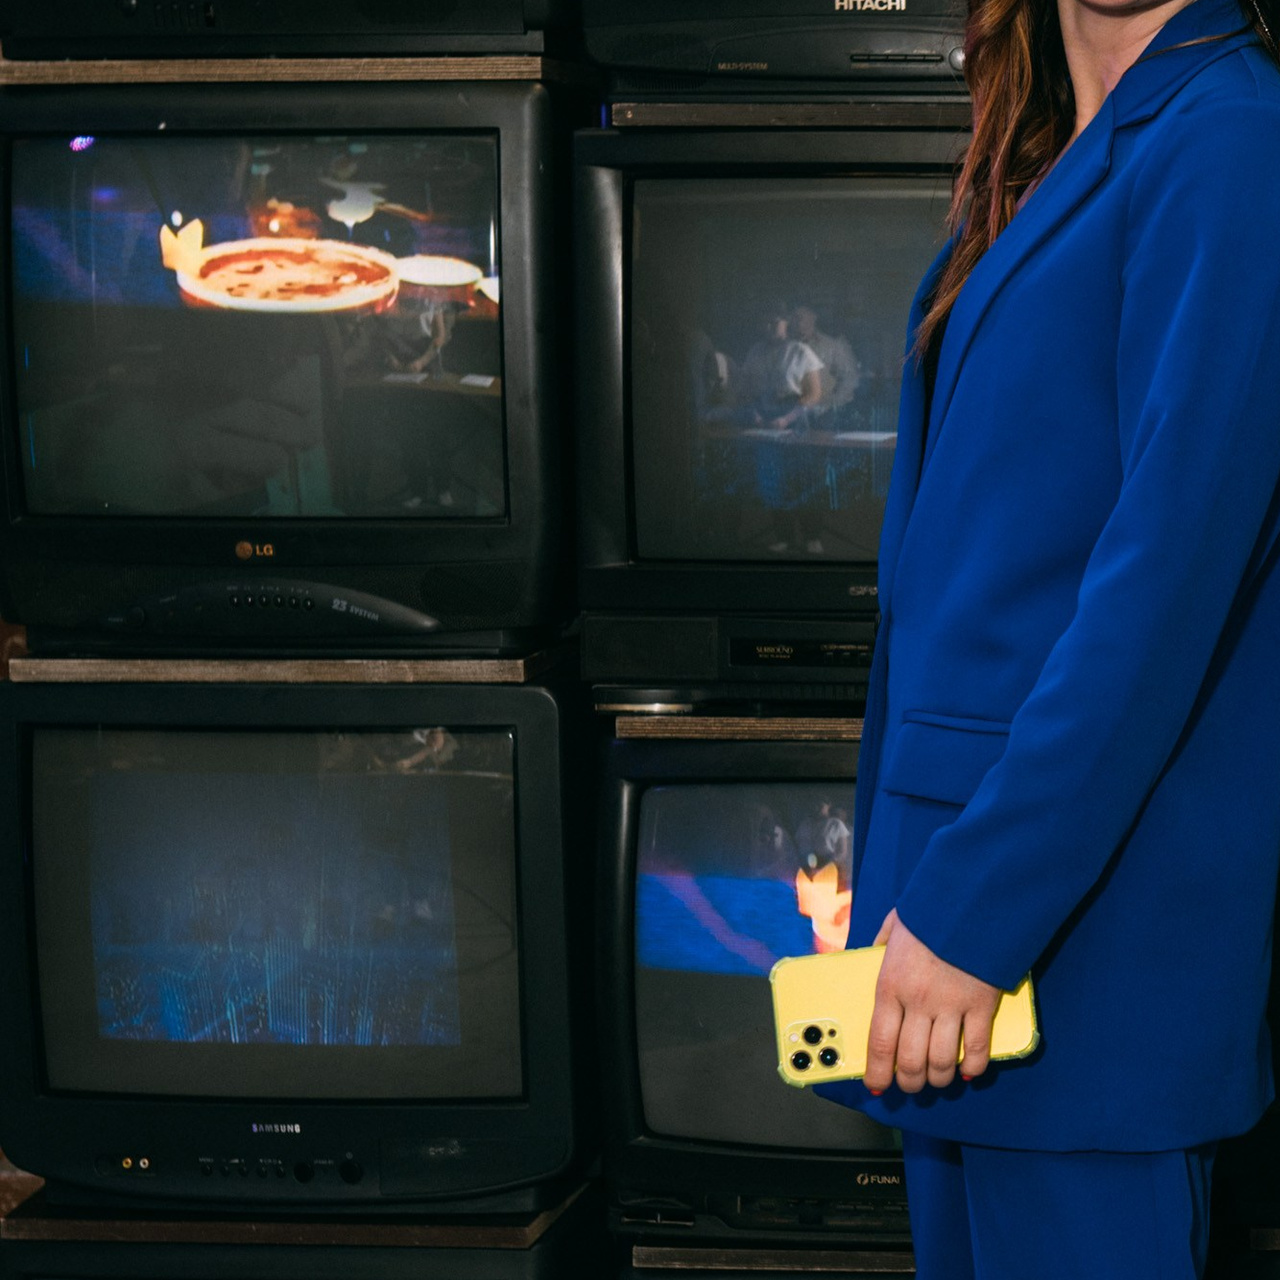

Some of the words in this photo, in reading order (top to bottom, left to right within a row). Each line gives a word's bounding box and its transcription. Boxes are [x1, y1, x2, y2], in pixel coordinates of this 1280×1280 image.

[255, 544, 274, 557] LG
[331, 598, 348, 612] 23
[349, 605, 380, 622] SYSTEM
[252, 1122, 301, 1134] SAMSUNG
[870, 1175, 900, 1186] FUNAI
